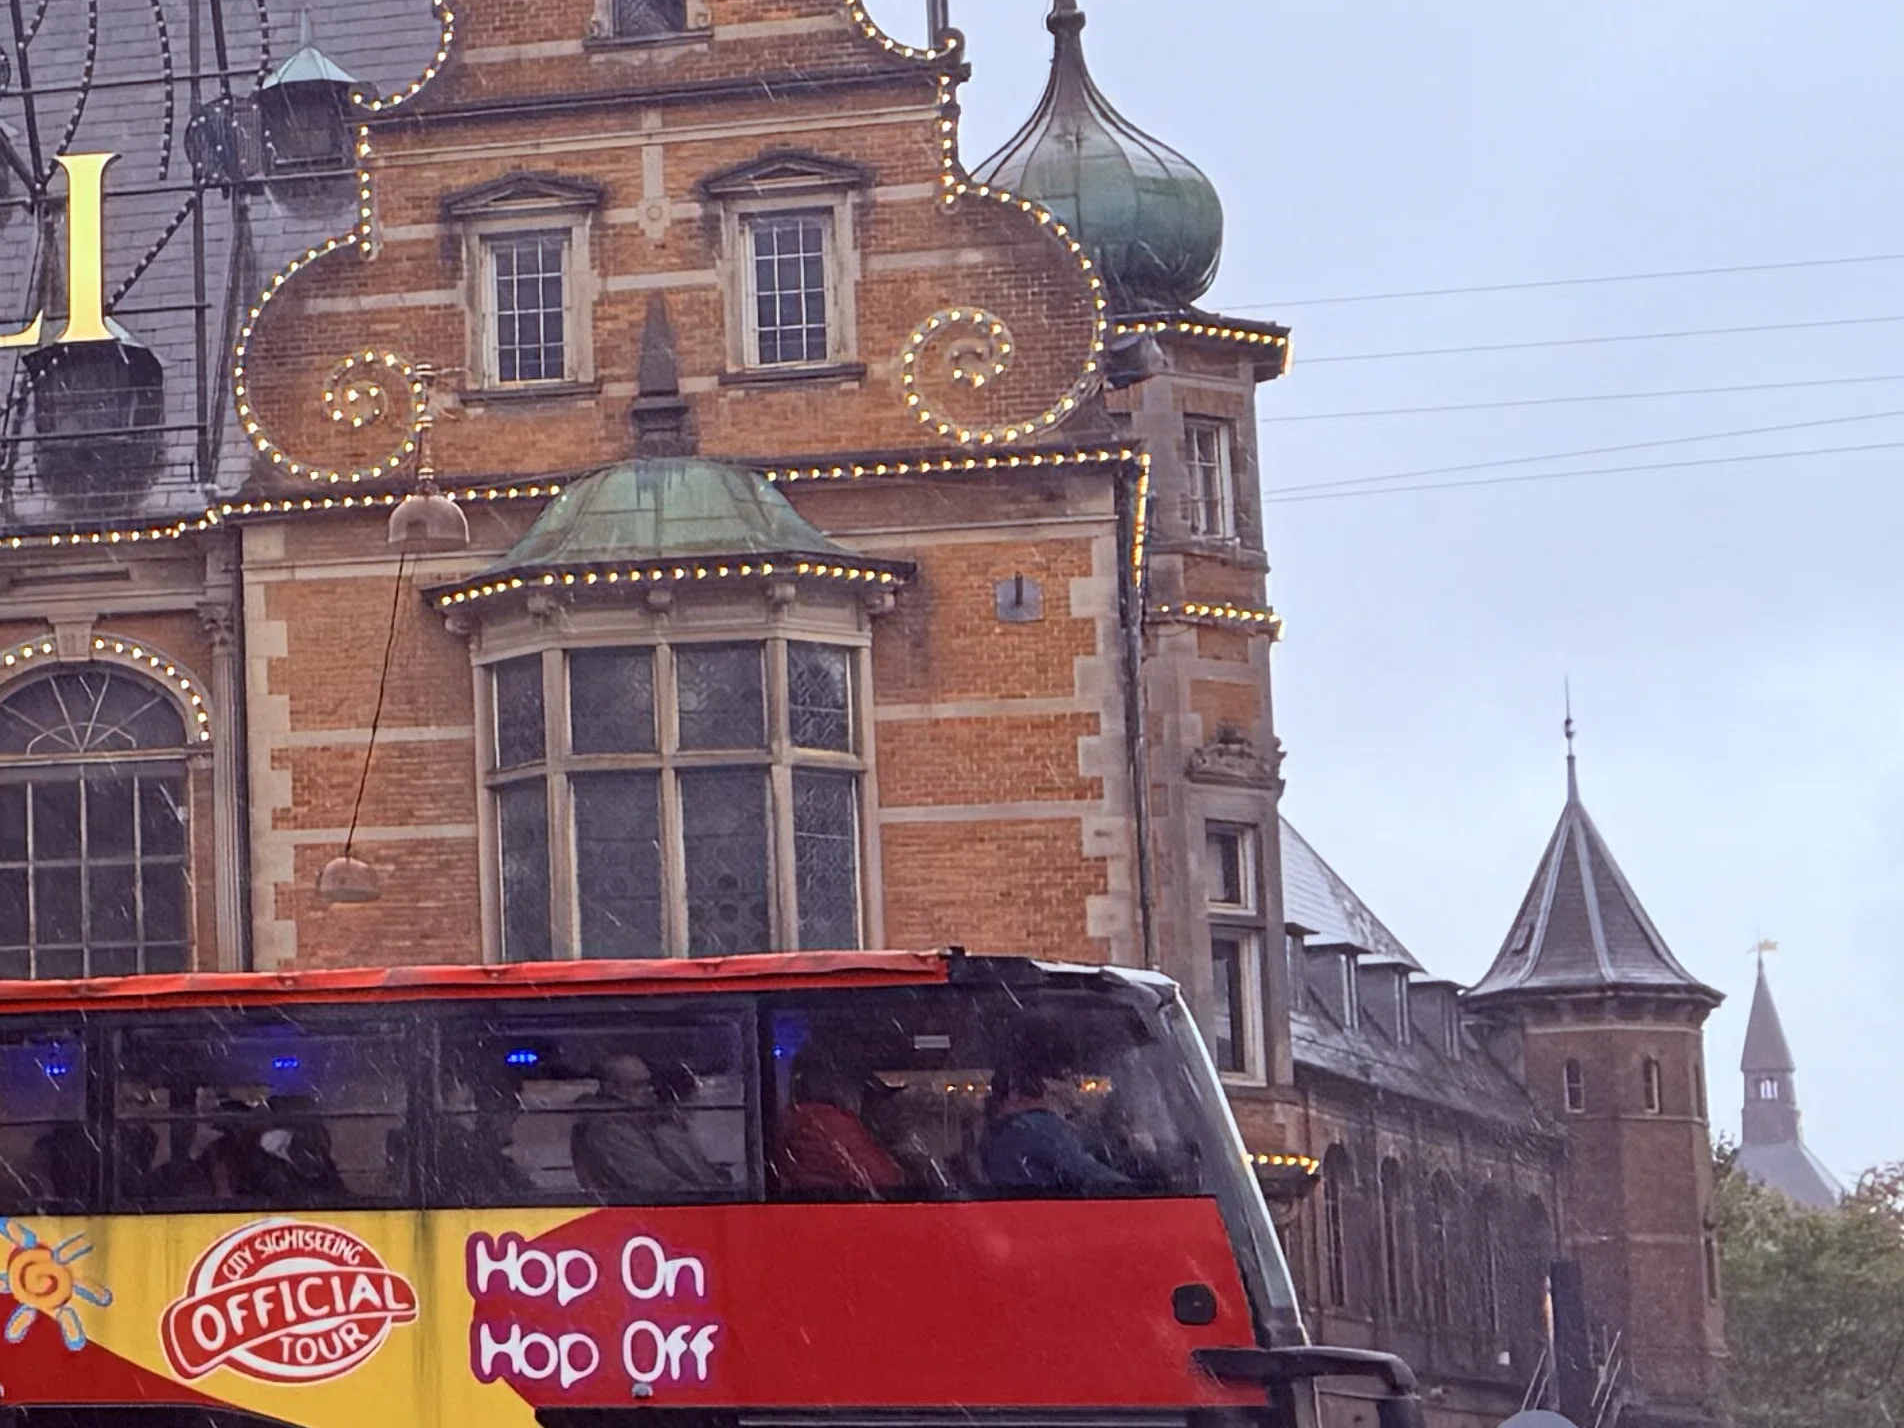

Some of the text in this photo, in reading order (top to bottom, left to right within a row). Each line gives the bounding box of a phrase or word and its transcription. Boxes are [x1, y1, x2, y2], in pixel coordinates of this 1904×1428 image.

[222, 1228, 364, 1281] CITY SIGHTSEEING
[475, 1235, 705, 1307] Hop On
[192, 1273, 410, 1351] OFFICIAL
[280, 1322, 370, 1364] TOUR
[480, 1320, 719, 1389] Hop Off
